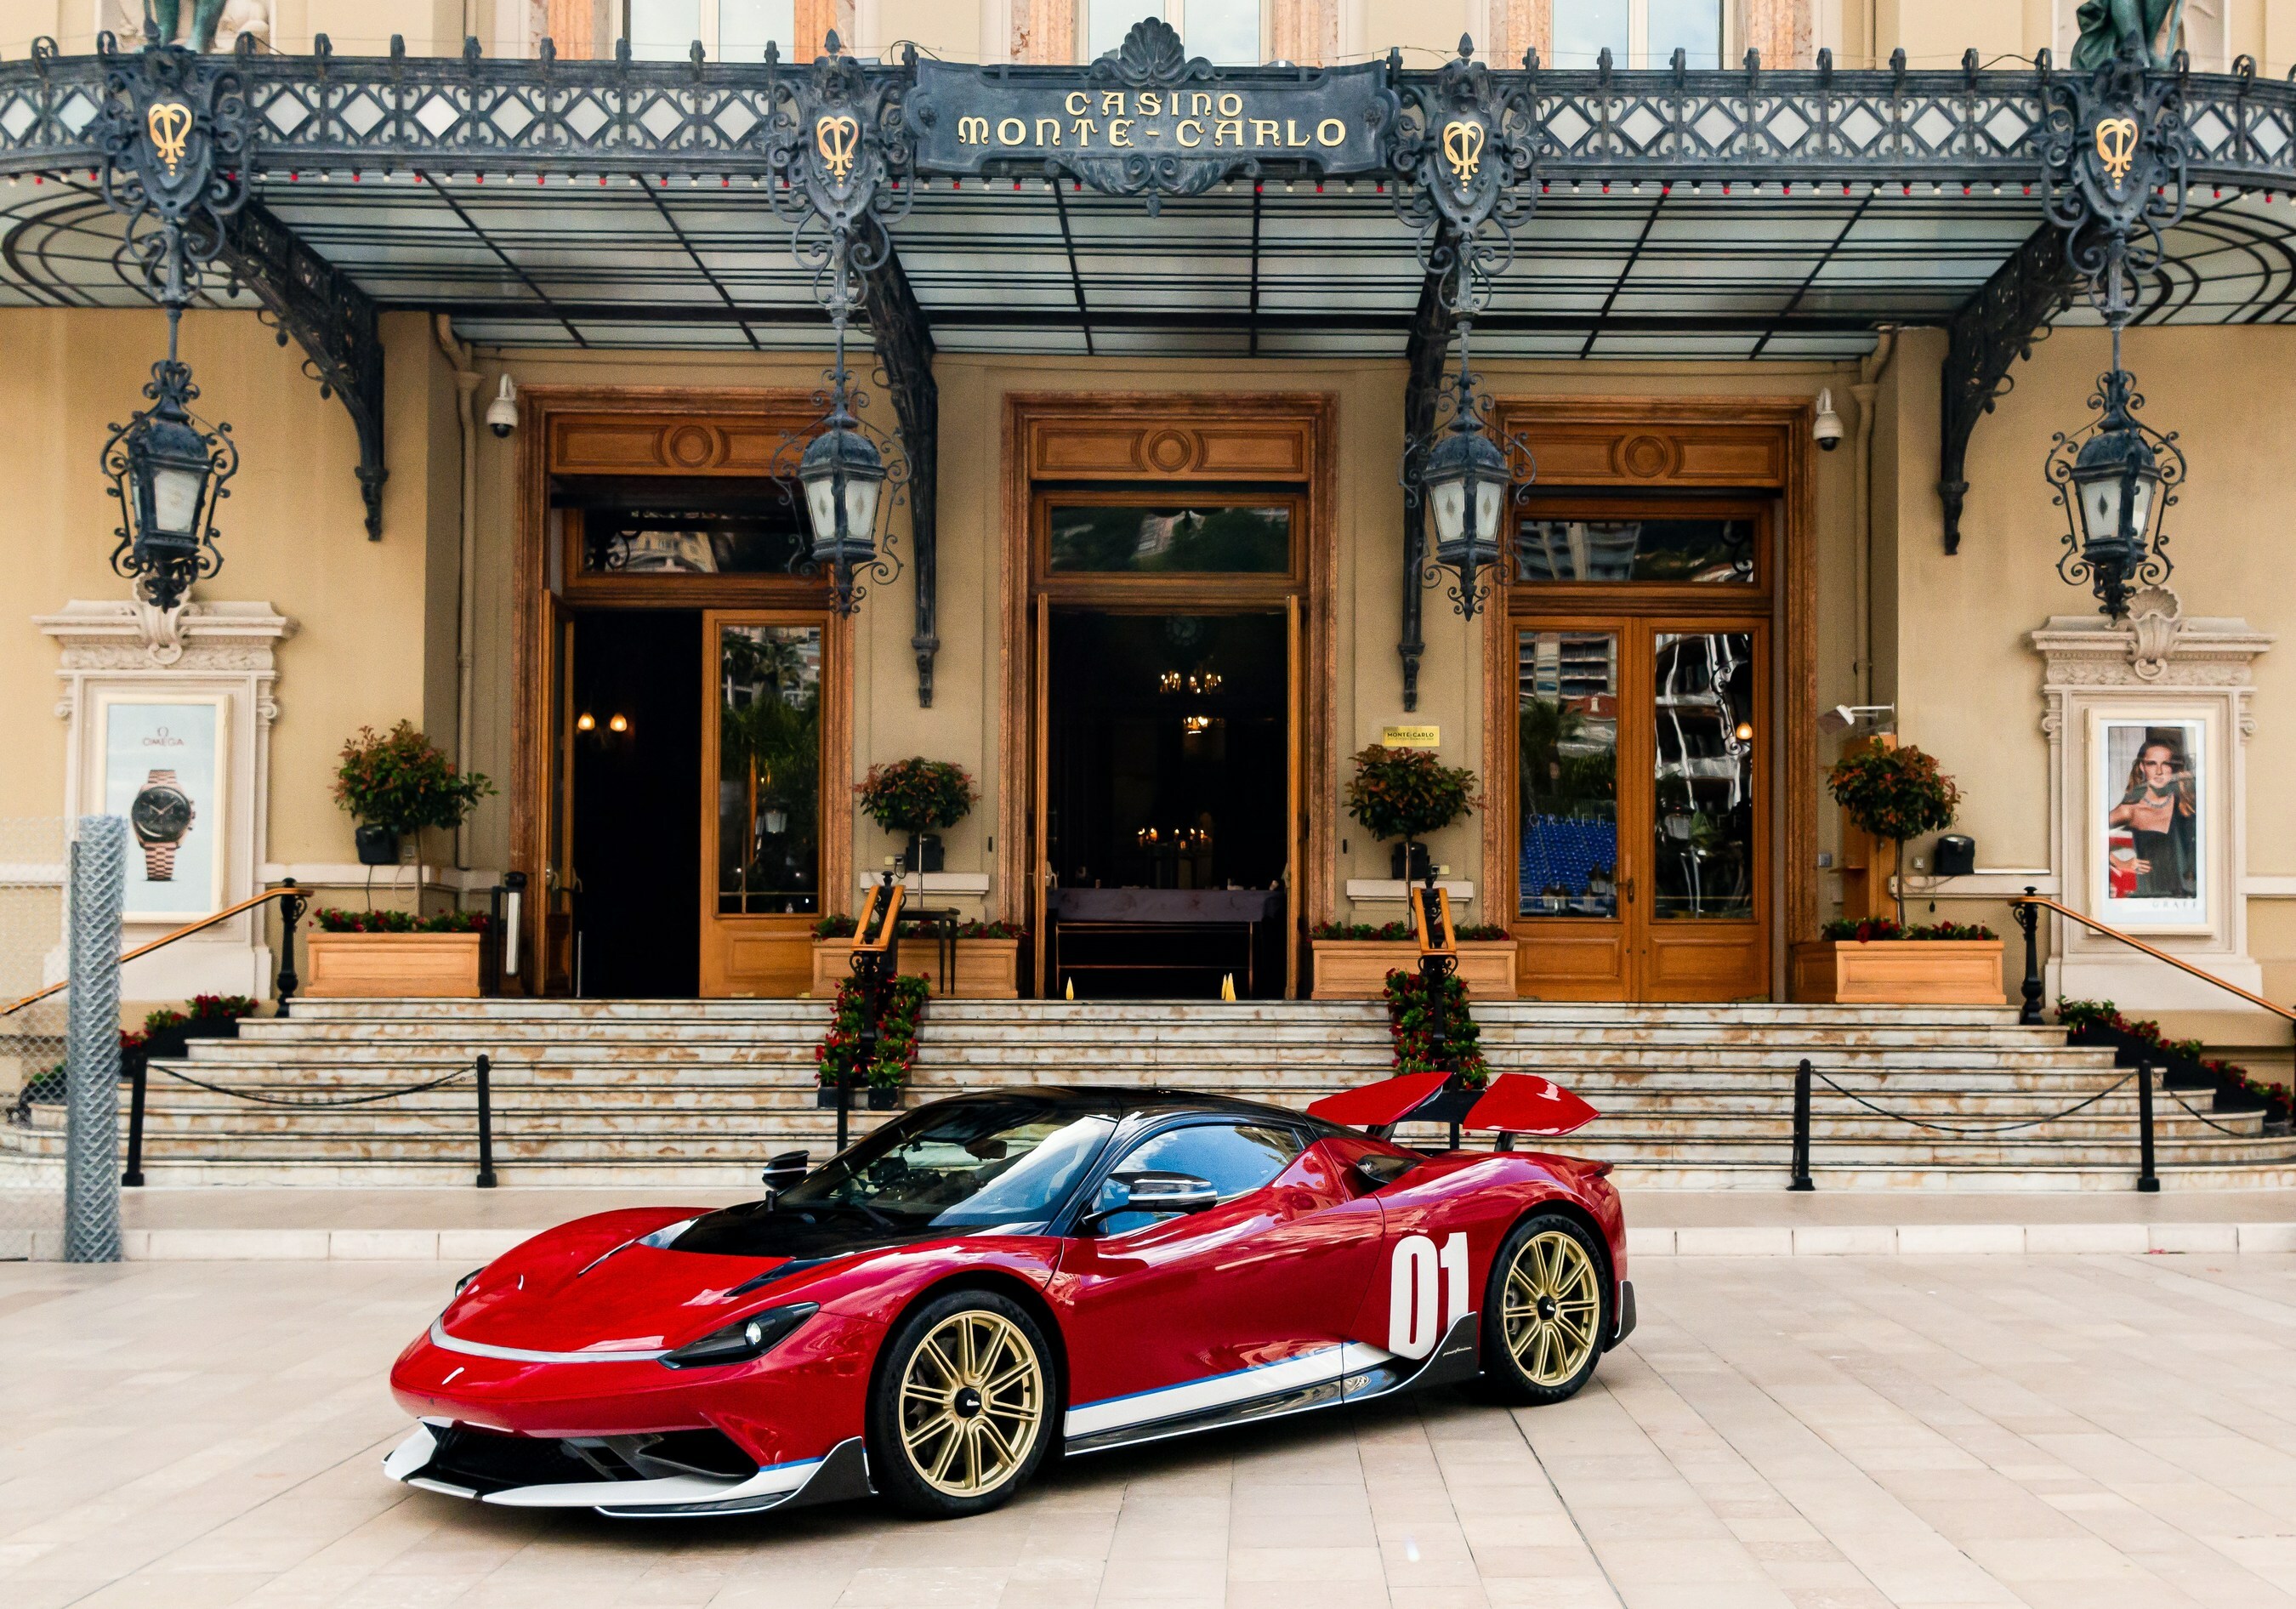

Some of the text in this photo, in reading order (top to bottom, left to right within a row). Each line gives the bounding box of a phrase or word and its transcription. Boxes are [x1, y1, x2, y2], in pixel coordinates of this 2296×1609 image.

[1065, 90, 1243, 117] CASINO
[143, 737, 185, 747] OMEGA
[1389, 1231, 1469, 1361] 01
